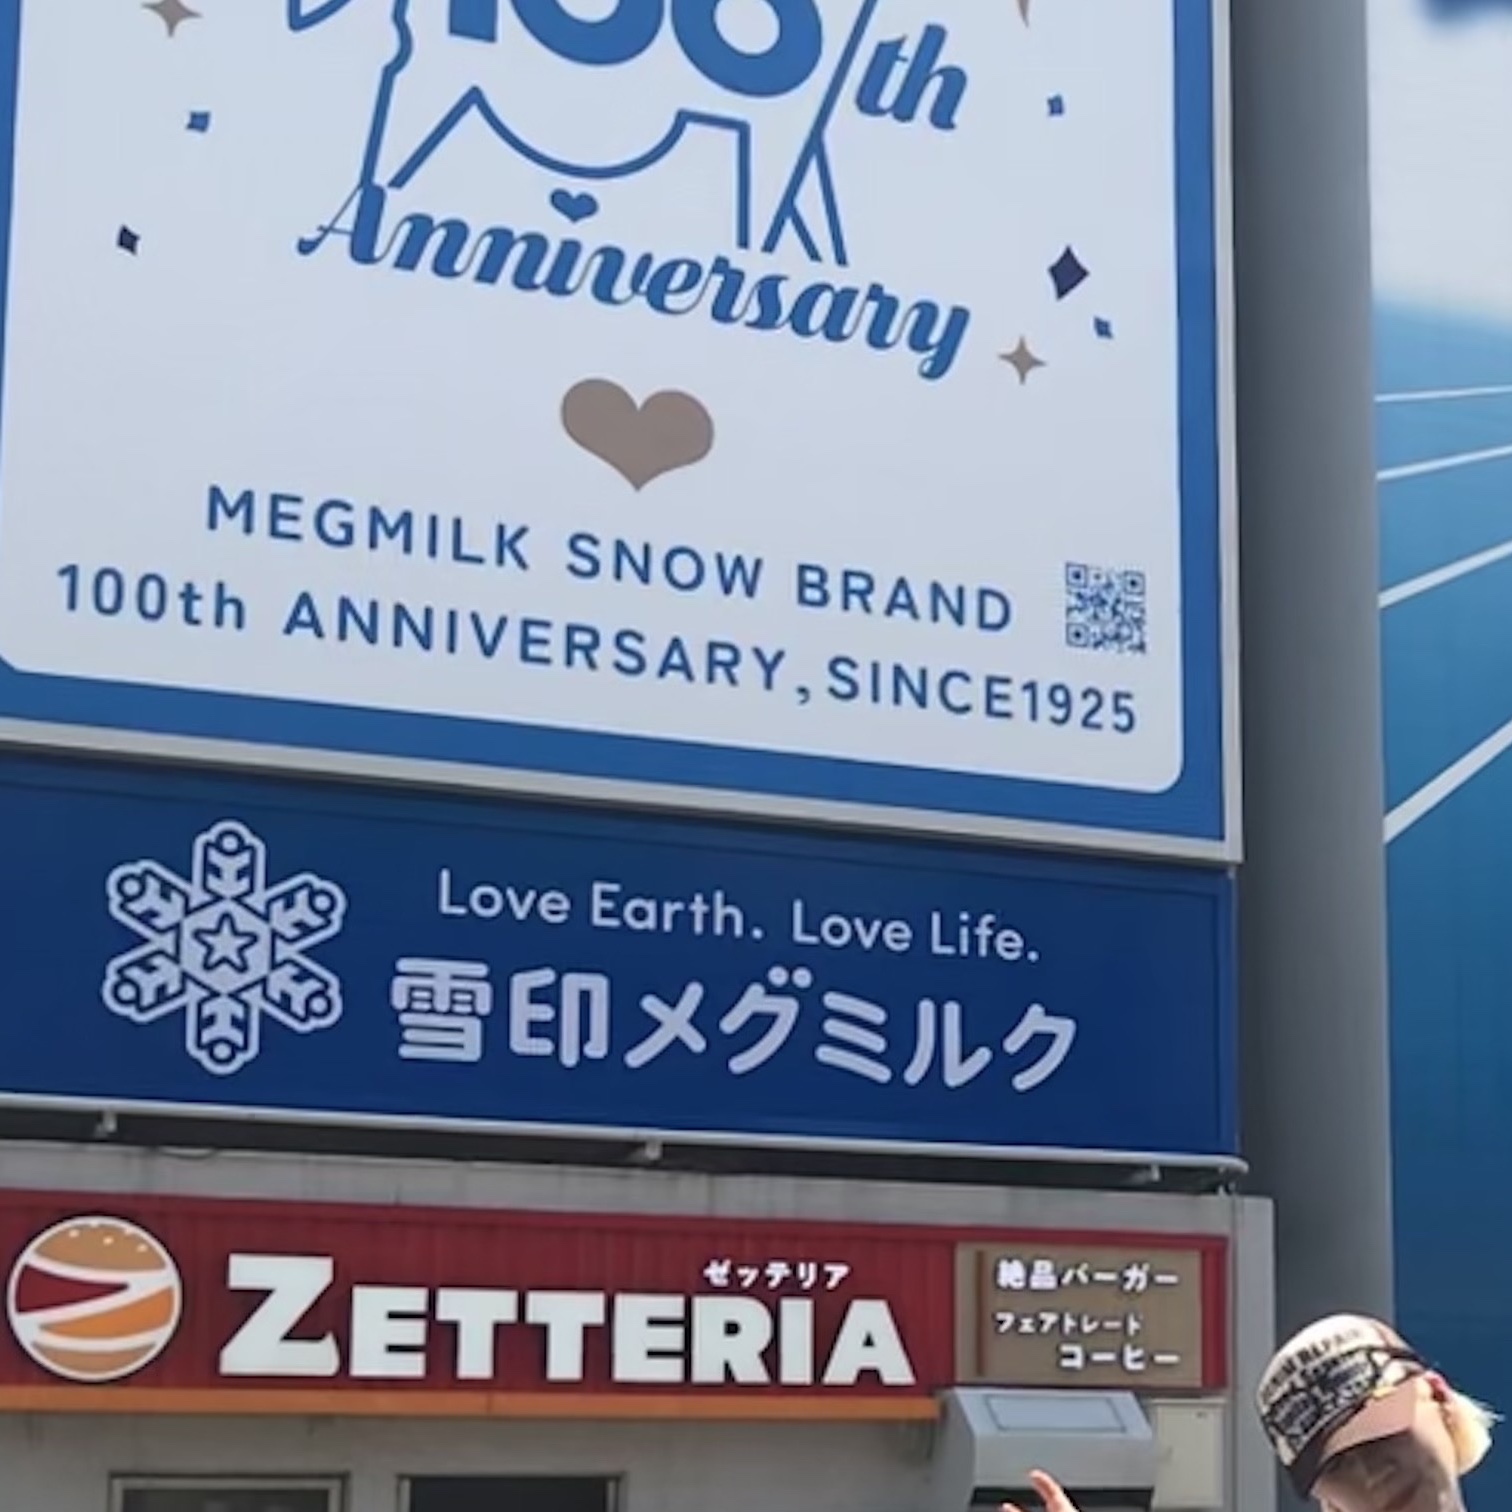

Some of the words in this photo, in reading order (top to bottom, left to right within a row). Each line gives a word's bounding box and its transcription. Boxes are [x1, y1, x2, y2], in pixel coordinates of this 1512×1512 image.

[297, 182, 970, 381] Anniversary
[56, 563, 246, 630] 100th
[207, 485, 531, 570] MEGMILK
[566, 532, 763, 600] SNOW
[797, 563, 1012, 632] BRAND
[437, 868, 570, 924] Love
[590, 882, 763, 940] Earth.
[791, 899, 913, 953] Love
[929, 911, 1040, 963] Life.
[389, 957, 1078, 1092] 雪印メグミルク
[703, 1259, 851, 1291] ゼッテリア
[997, 1258, 1180, 1292] 絶品バーガー
[218, 1253, 917, 1387] ZETTERIA
[995, 1311, 1144, 1336] フェアトレード
[1060, 1343, 1181, 1370] コーヒー
